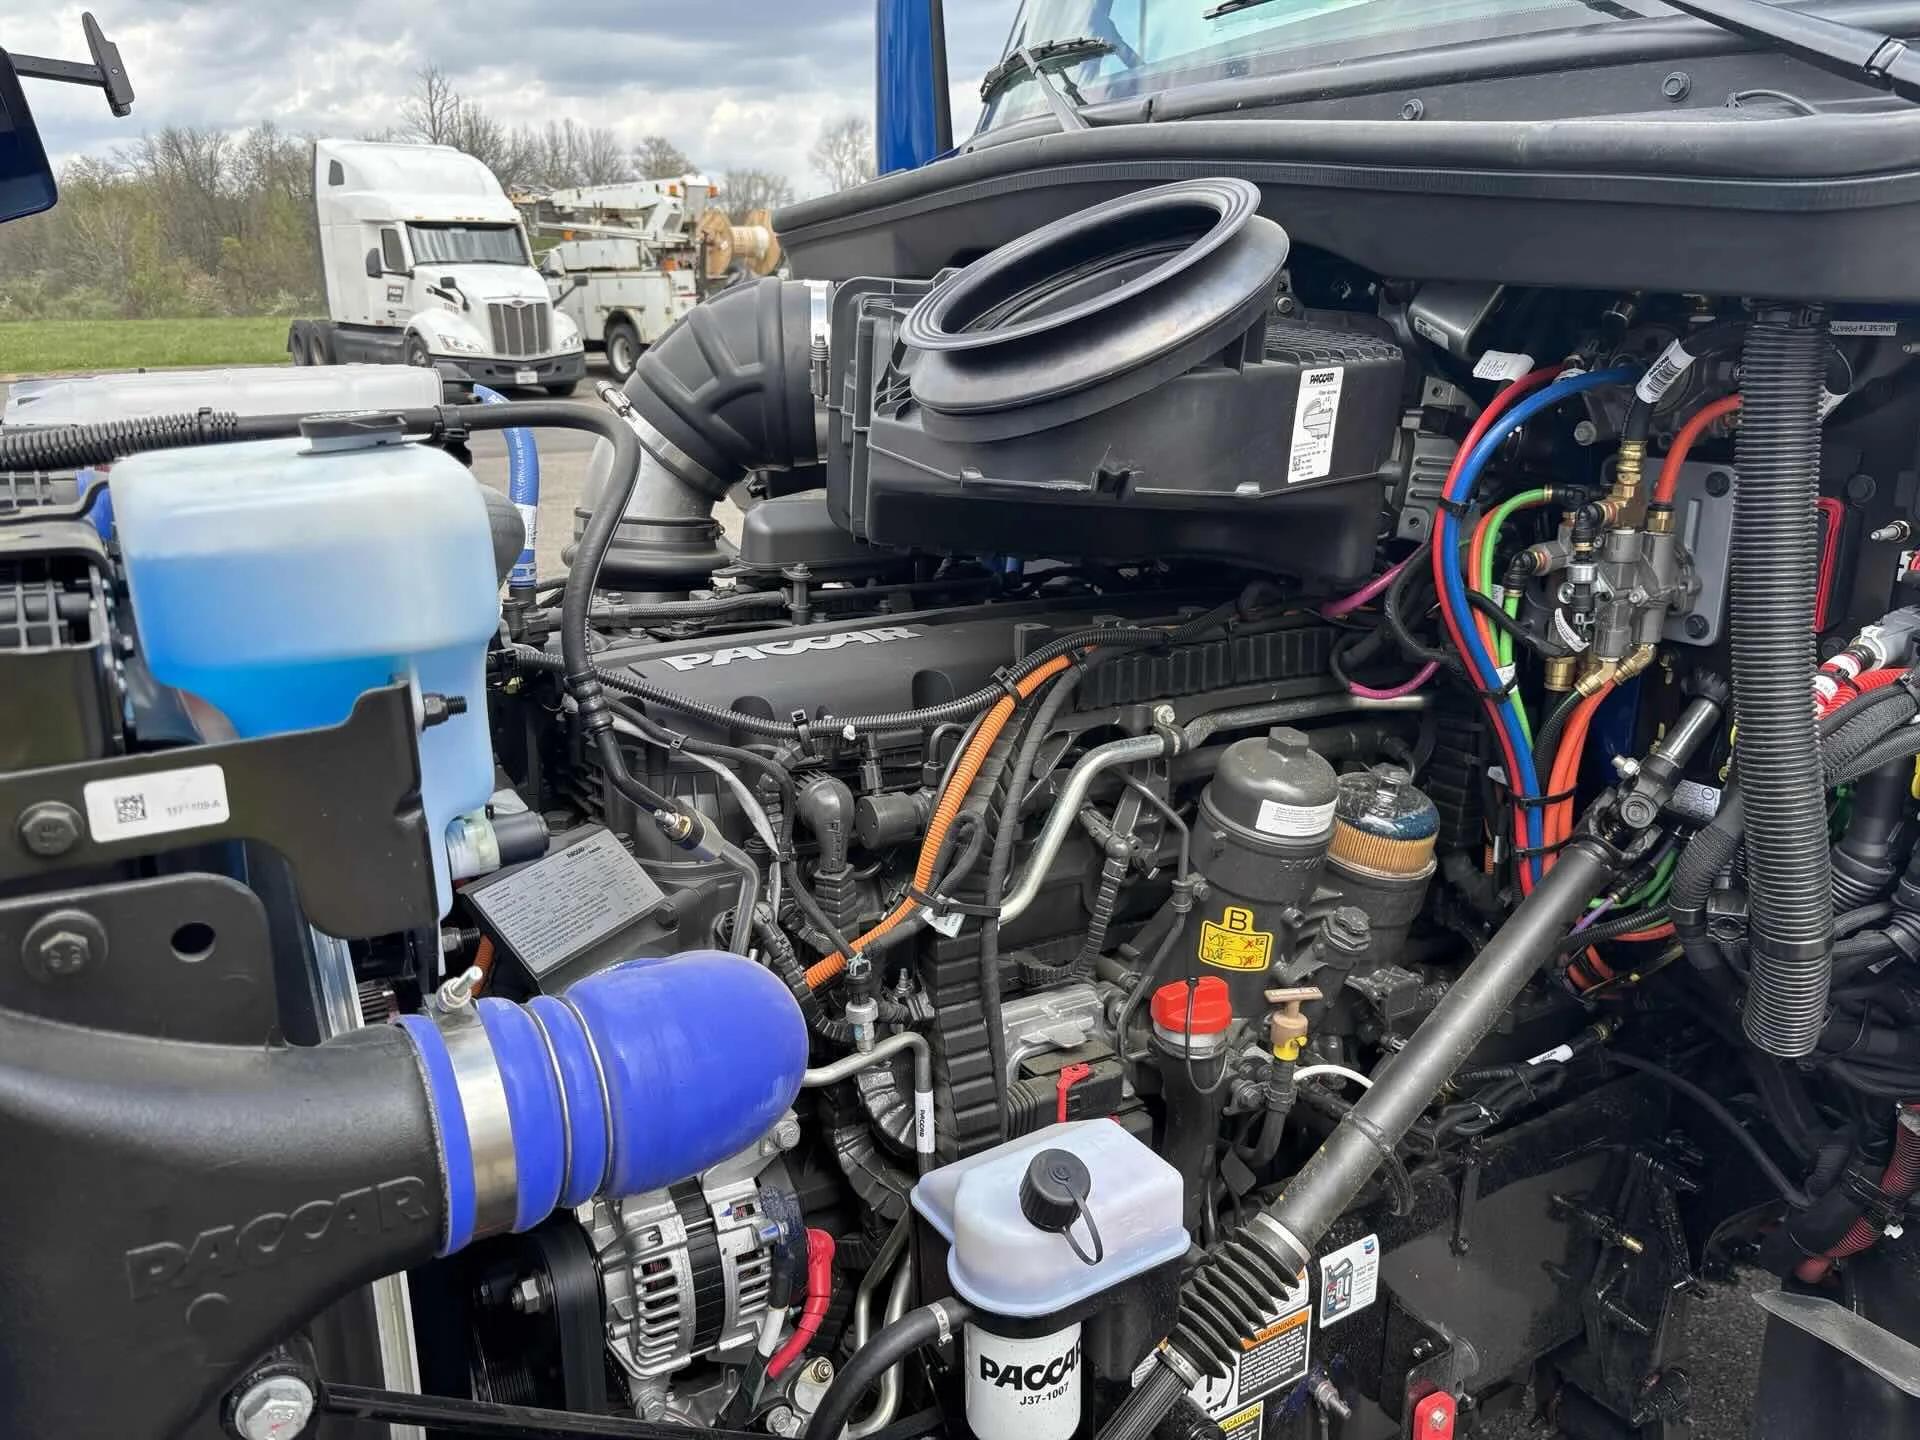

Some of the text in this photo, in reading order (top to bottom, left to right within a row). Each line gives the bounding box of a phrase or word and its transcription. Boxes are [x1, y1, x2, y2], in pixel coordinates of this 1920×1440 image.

[1309, 372, 1335, 385] PACCAR
[661, 626, 923, 672] PACCAR
[1230, 909, 1248, 931] B
[126, 1176, 430, 1302] PACCAR
[1260, 1318, 1297, 1341] WARNING
[1019, 1382, 1069, 1406] J37-1007
[1227, 1407, 1260, 1429] CAUTION
